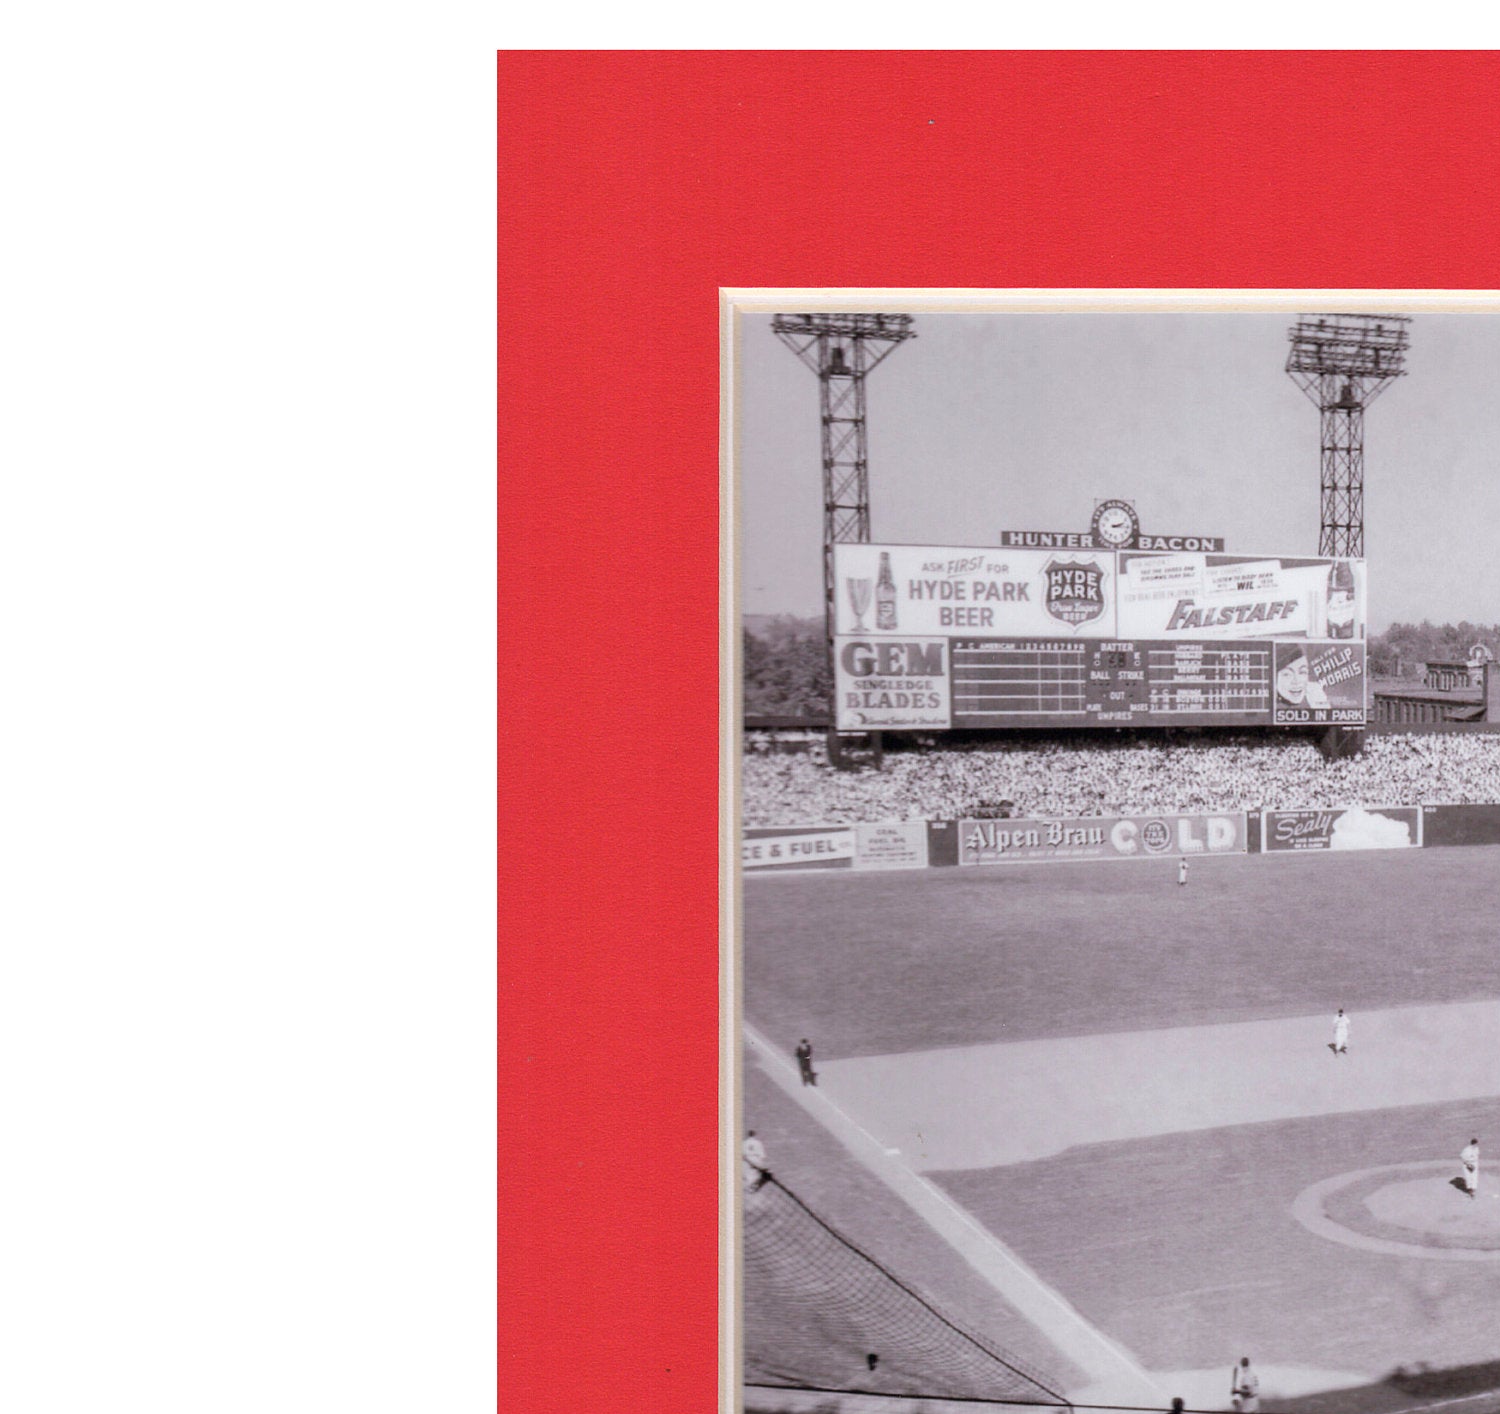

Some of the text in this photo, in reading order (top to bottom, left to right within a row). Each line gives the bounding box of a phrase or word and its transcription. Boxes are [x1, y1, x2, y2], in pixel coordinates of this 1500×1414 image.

[1009, 532, 1094, 547] HUNTER
[1139, 537, 1215, 550] BACON
[922, 556, 1009, 574] ASK FIRST FOR
[1051, 570, 1098, 585] HYDE
[1237, 580, 1255, 591] WIL
[909, 579, 1030, 602] HYDE PARK
[1051, 585, 1099, 600] PARK
[939, 606, 994, 627] BEER
[1165, 600, 1298, 631] FALSTAFF
[841, 642, 945, 677] GEM
[1313, 647, 1352, 677] PHILIP
[1090, 670, 1144, 679] BALL STRIKE
[1319, 661, 1361, 687] MORRIS
[853, 680, 934, 690] SINGLEDGE
[845, 692, 941, 709] BLADES
[1277, 710, 1363, 721] SOLD IN PARK
[1275, 811, 1333, 841] Sealy
[965, 822, 1106, 852] Alpen Brau
[1111, 817, 1235, 855] COLD
[770, 844, 782, 858] &
[790, 839, 837, 856] FUEL
